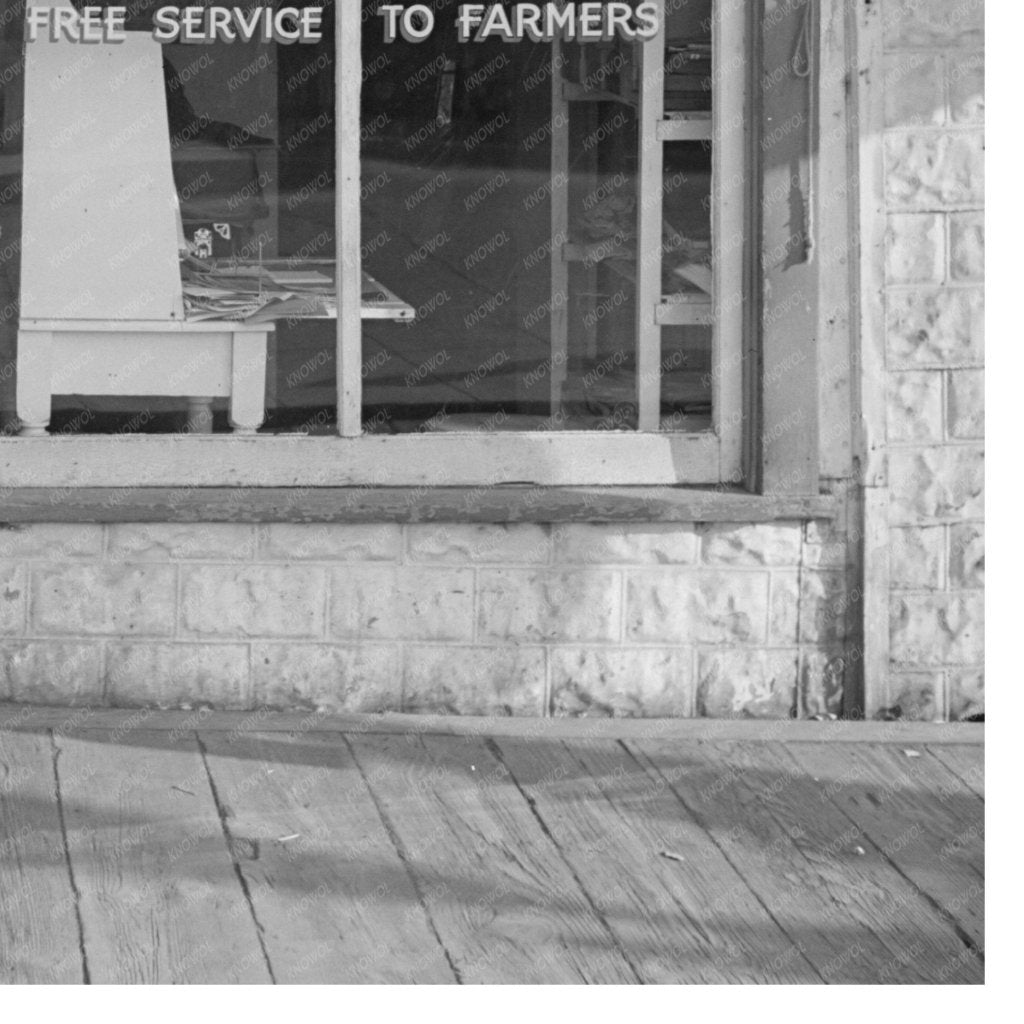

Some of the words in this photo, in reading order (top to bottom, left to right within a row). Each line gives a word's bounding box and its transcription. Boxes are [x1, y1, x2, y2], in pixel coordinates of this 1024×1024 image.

[27, 5, 126, 41] FREE
[155, 5, 324, 40] SERVICE
[382, 3, 434, 39] TO
[458, 1, 664, 39] FARMERS
